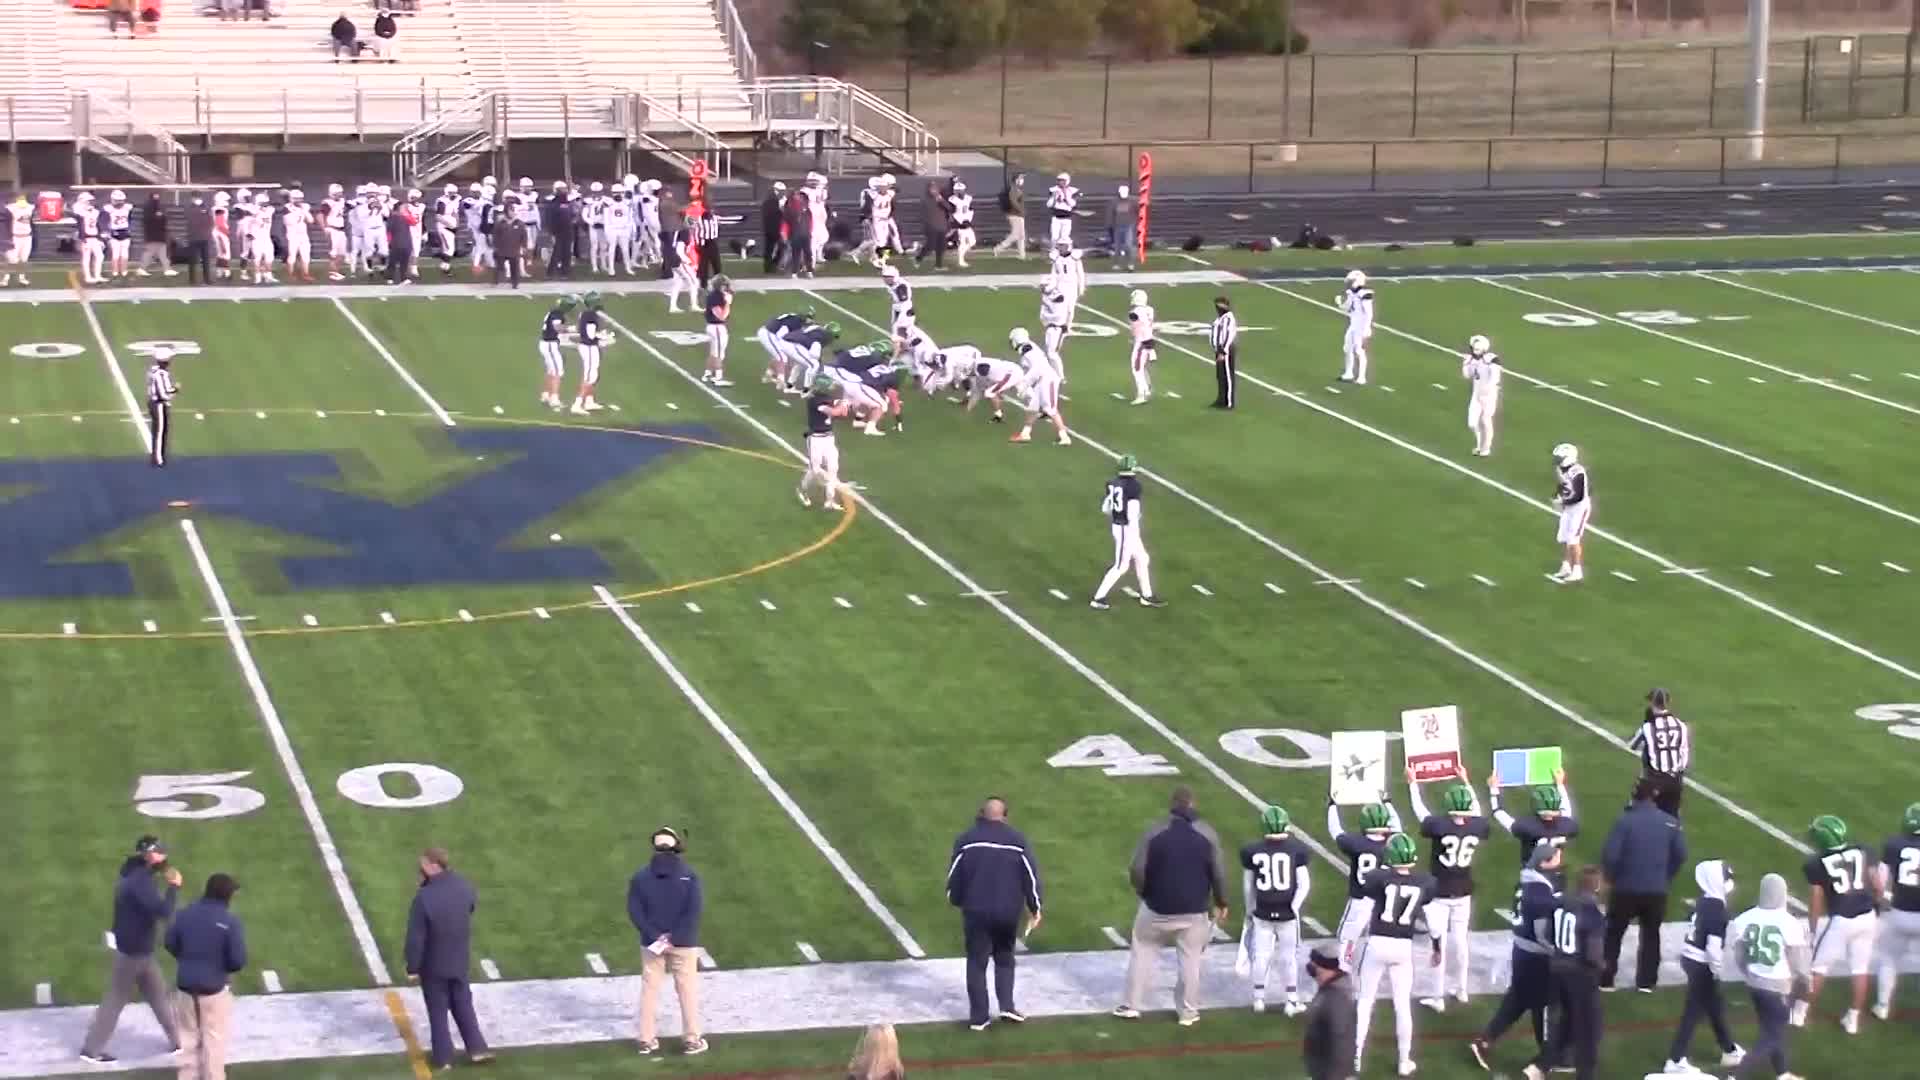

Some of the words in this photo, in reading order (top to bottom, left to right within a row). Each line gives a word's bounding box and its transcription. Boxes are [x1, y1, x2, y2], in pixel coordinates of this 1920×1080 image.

[1656, 730, 1680, 749] 37
[1438, 834, 1479, 867] 36
[1822, 848, 1864, 895] 57
[1252, 852, 1291, 892] 30
[1380, 883, 1421, 925] 17
[1553, 907, 1577, 954] 10
[1741, 921, 1783, 968] 85
